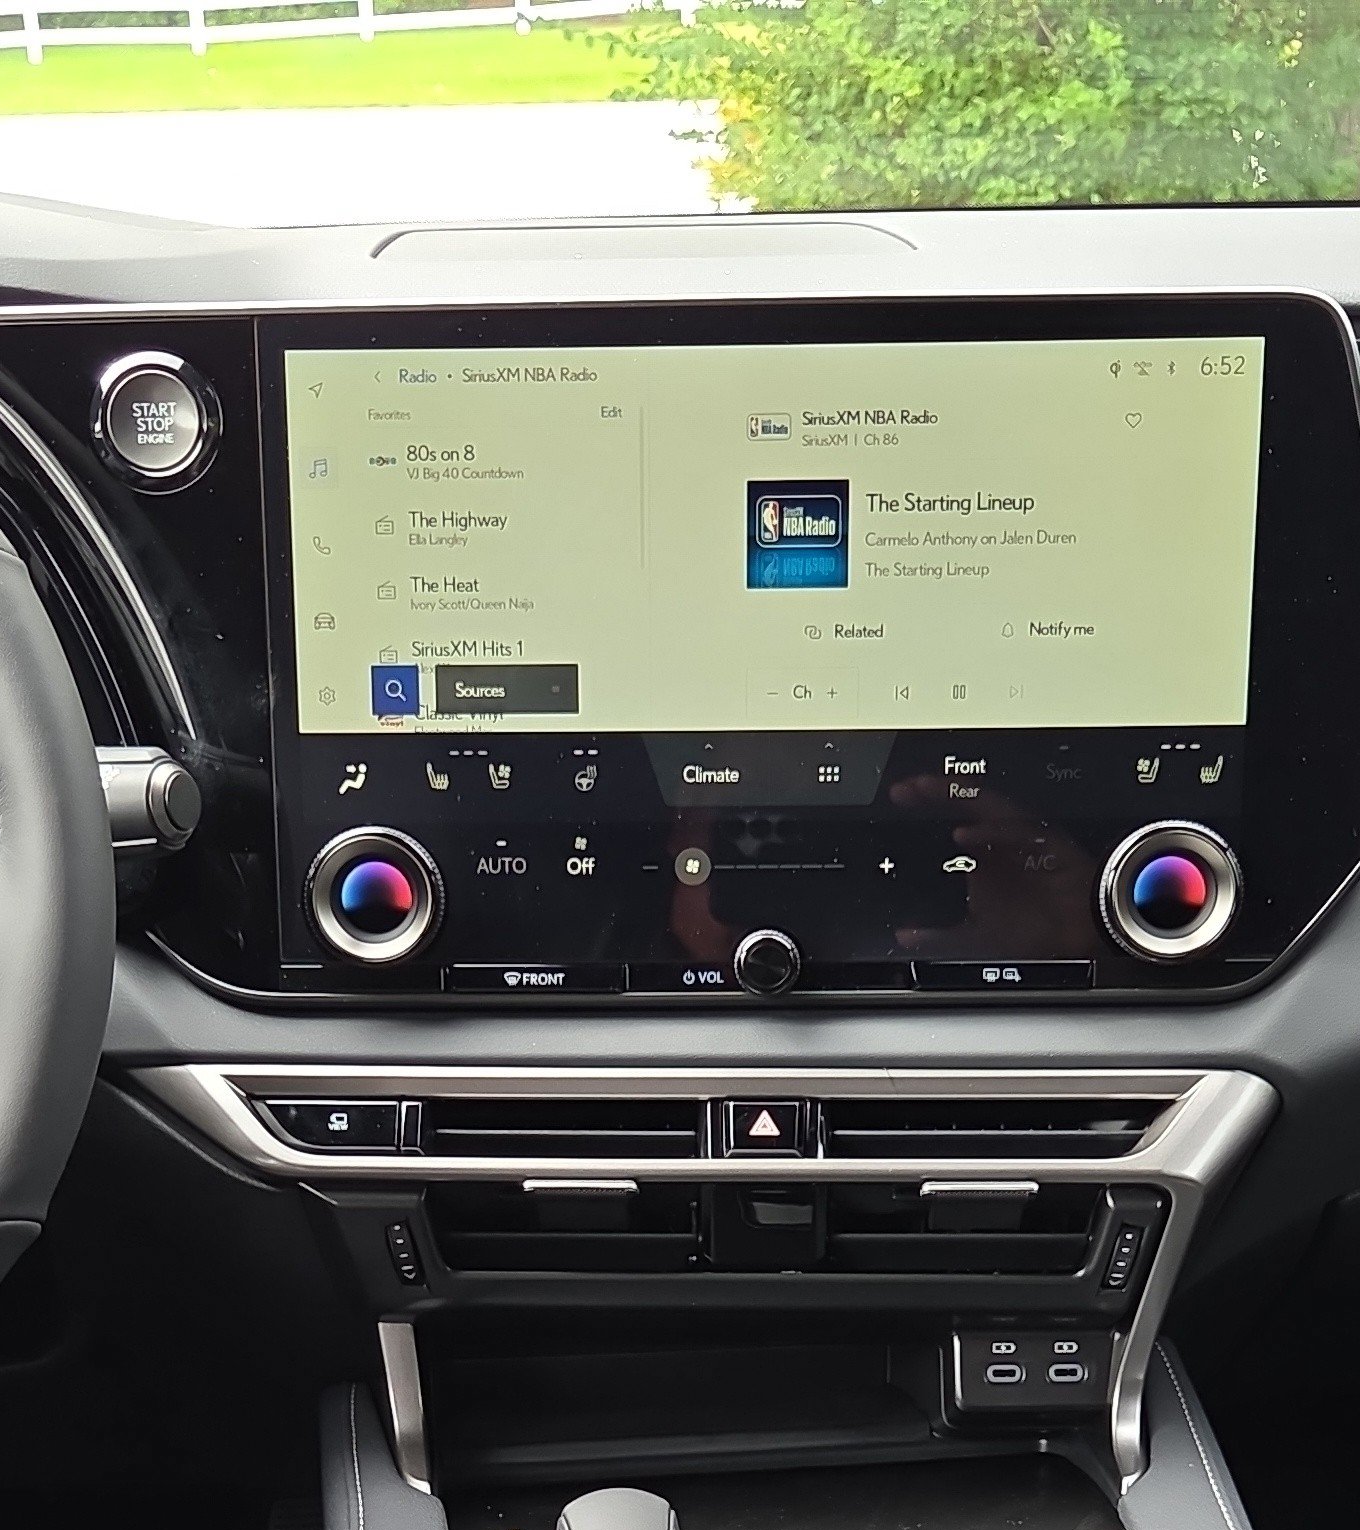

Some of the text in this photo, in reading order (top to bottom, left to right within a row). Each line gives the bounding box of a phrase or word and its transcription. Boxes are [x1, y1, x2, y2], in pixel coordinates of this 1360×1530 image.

[1200, 355, 1246, 376] 6:52
[399, 367, 598, 383] Radio SiriusXM NBA Radio
[132, 402, 177, 418] START
[368, 408, 411, 421] Favorites
[601, 406, 622, 419] Edit
[802, 410, 939, 426] SiriusXM NBA Radio
[136, 418, 174, 432] STOP
[137, 433, 175, 445] ENGINE
[801, 433, 899, 447] SiriusXM Ch 86
[406, 445, 437, 462] 80s
[441, 450, 459, 462] on
[464, 444, 475, 462] 8
[407, 467, 524, 482] VJ Big 40 Countdown
[866, 492, 1035, 515] The Starting Lineup
[408, 510, 507, 531] The Highway
[783, 516, 836, 536] NBA Radio
[409, 533, 468, 547] Ella Langley
[865, 529, 1077, 548] Carmelo Anthony on Jalen Duren
[865, 562, 990, 580] The Starting Lineup
[410, 576, 480, 592] The Heat
[411, 600, 435, 611] Ivory
[440, 599, 505, 610] Scott/Queen
[834, 624, 884, 640] Related
[1029, 622, 1095, 639] Notify me
[412, 640, 523, 657] SiriusXM Hits 1
[455, 682, 505, 697] Sources
[793, 685, 812, 700] Ch
[943, 756, 987, 775] Front
[682, 765, 740, 785] Climate
[949, 783, 980, 799] Rear
[476, 856, 527, 876] AUTO
[566, 856, 595, 876] Off
[522, 973, 566, 987] FRONT
[698, 970, 725, 985] VOL
